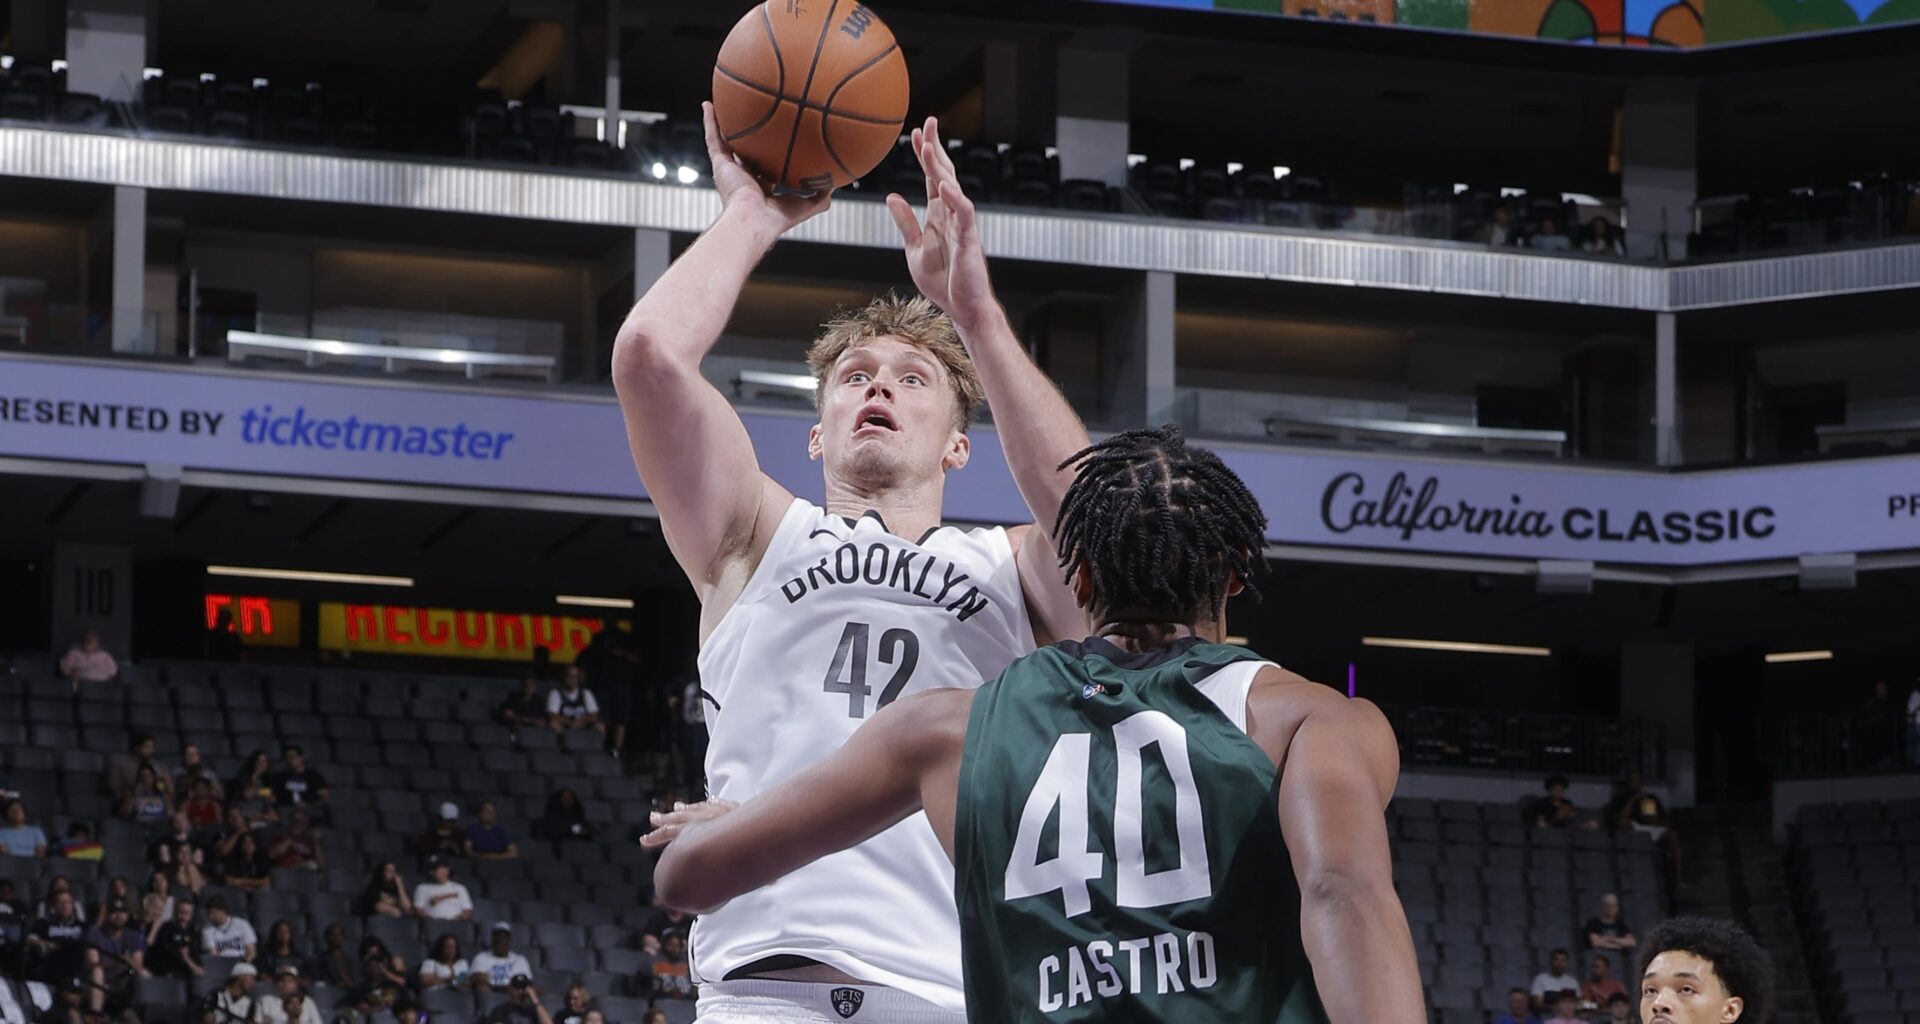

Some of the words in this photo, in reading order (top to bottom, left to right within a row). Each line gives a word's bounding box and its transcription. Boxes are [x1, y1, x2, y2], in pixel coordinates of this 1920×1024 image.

[0, 398, 169, 432] RESENTED
[180, 410, 223, 437] BY
[241, 405, 514, 461] ticketmaster
[1320, 472, 1554, 541] California
[1562, 506, 1776, 545] CLASSIC
[74, 567, 116, 617] 110
[823, 621, 919, 719] 42
[1005, 710, 1212, 919] 40
[833, 990, 861, 1003] NETS
[1038, 931, 1218, 1013] CASTRO
